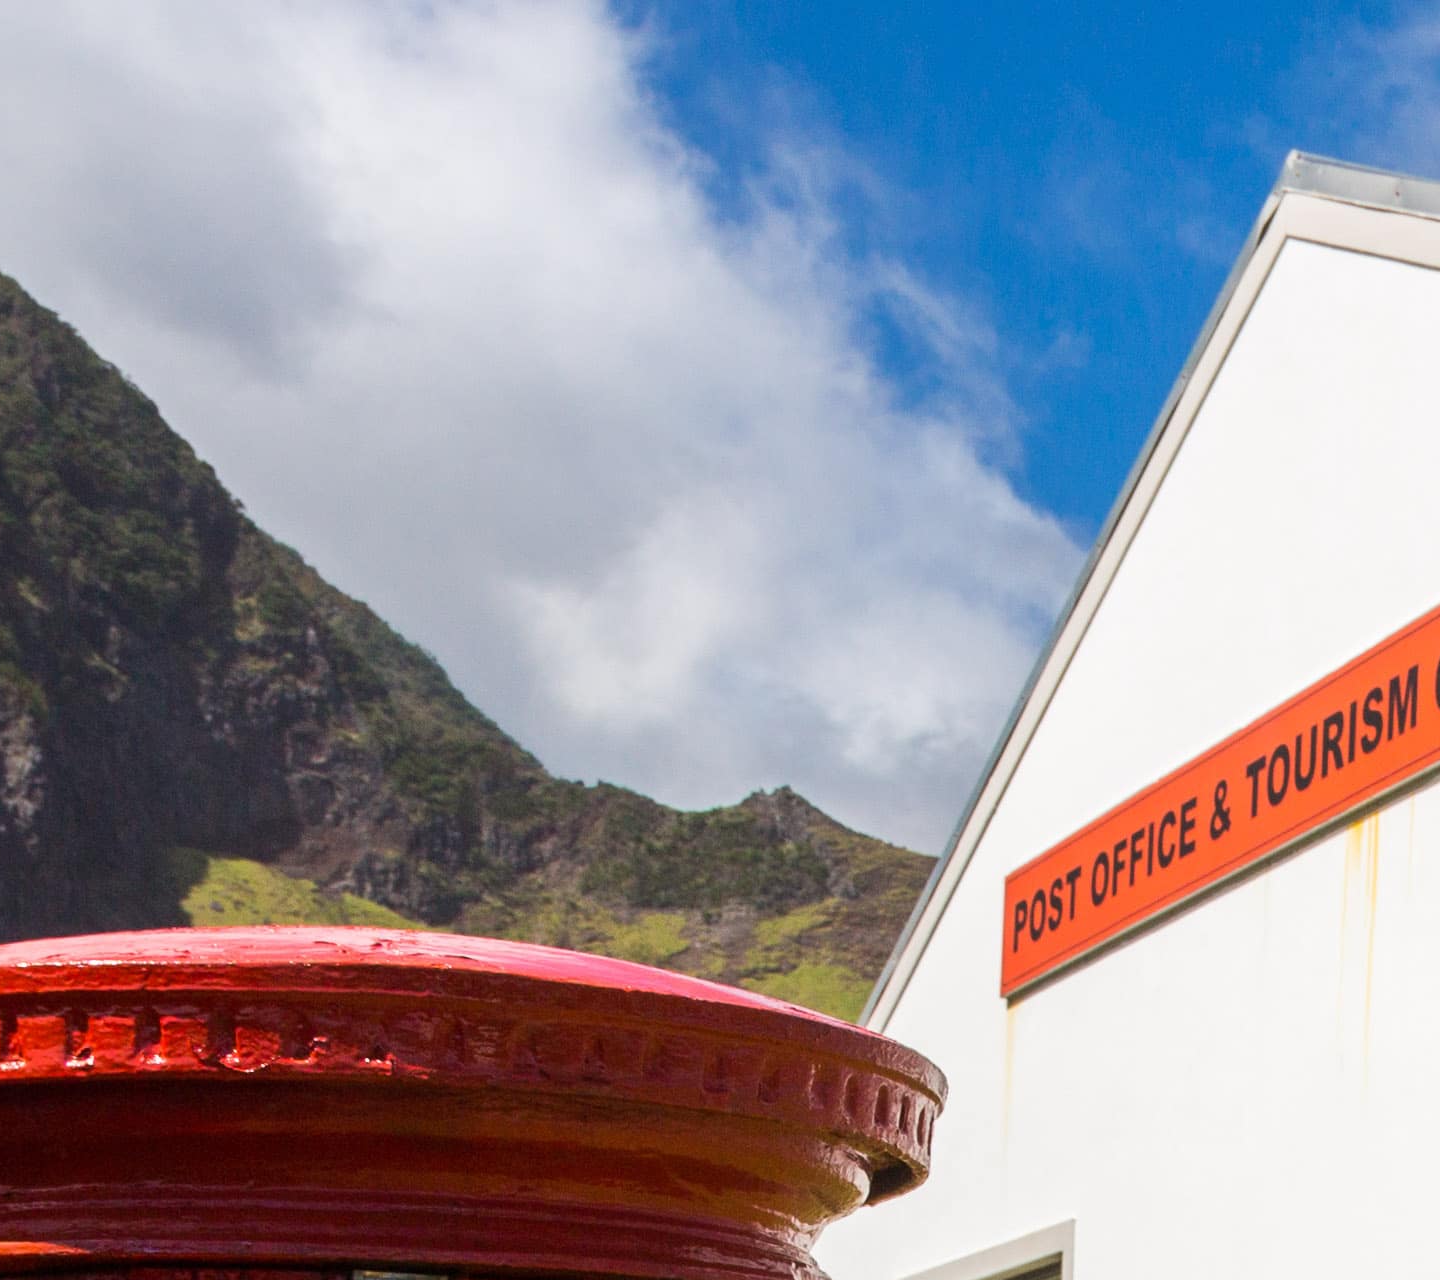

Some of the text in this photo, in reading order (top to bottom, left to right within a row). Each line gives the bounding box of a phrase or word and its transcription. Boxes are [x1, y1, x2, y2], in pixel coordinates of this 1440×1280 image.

[1012, 865, 1082, 953] POST
[1090, 796, 1198, 907] OFFICE
[1209, 779, 1232, 840] &
[1245, 664, 1420, 817] TOURISM
